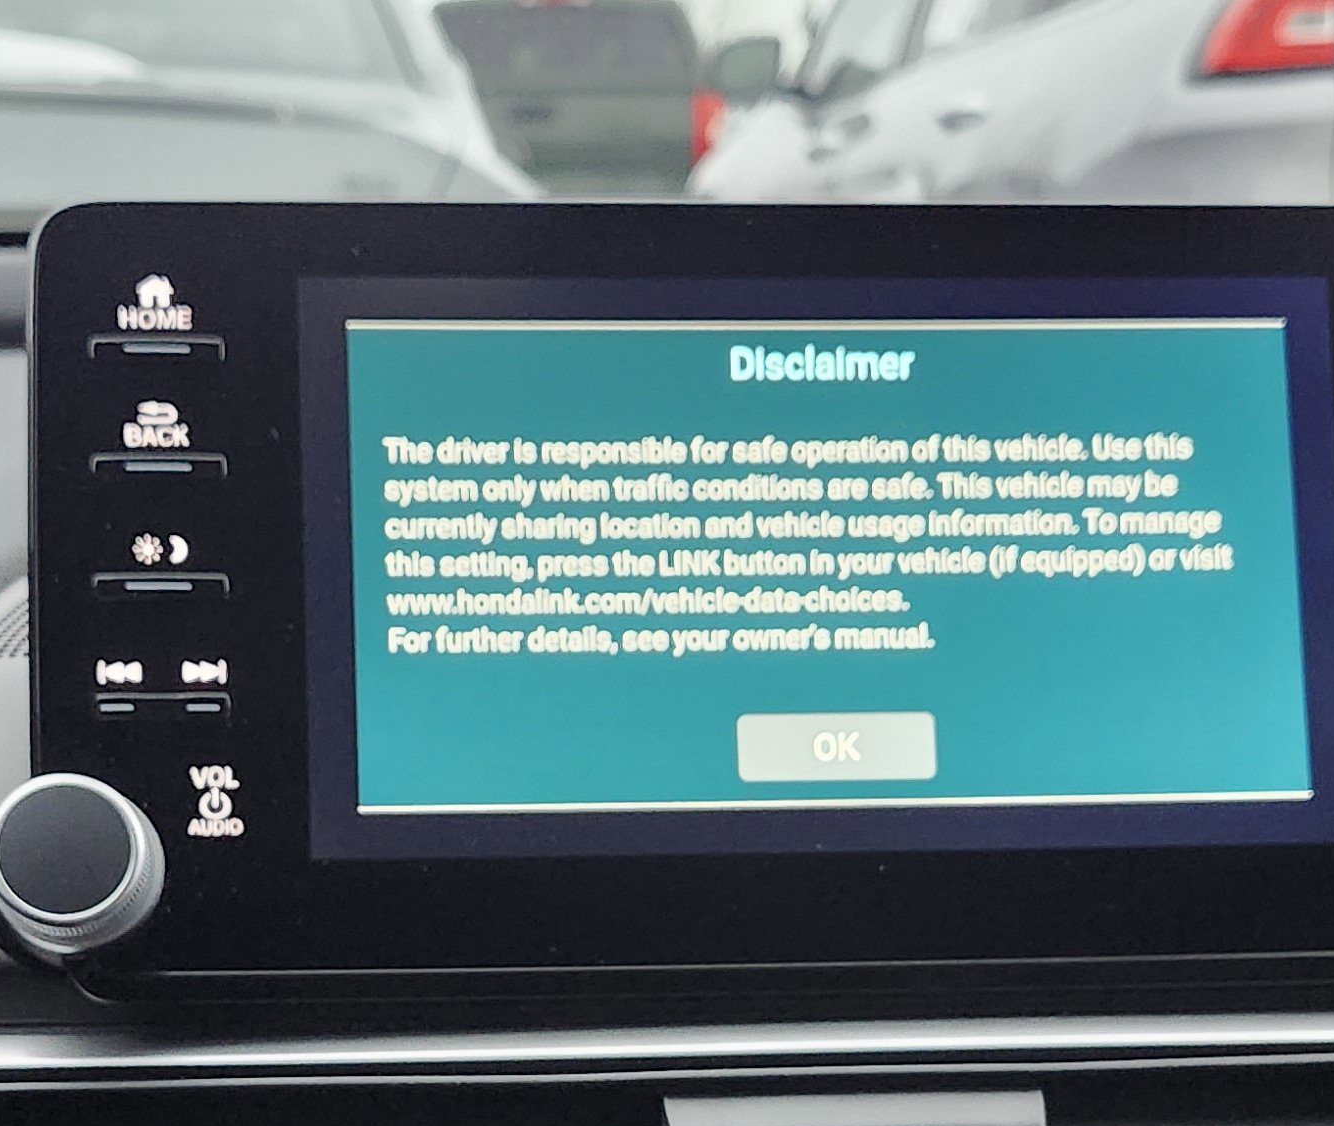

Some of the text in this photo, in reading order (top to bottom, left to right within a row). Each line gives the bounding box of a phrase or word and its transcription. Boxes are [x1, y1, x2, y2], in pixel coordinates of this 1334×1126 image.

[117, 305, 192, 330] HOME
[730, 344, 915, 381] Disclaimer
[123, 423, 190, 448] BACK
[383, 432, 1193, 469] The driver is responsible for safe operation of this vehicle. Use this
[385, 470, 1178, 507] system only when traffic conditions are safe. This vehicle may be
[385, 507, 1221, 545] currently sharing location and vehicle usage information. To manage
[385, 543, 1232, 582] this setting, press the LINK button in your vehicle (if equipped) or visit
[387, 586, 910, 615] www.hondalink.com/vehicle-data-choices.
[388, 622, 935, 656] For further details, see your owner's manual.
[813, 731, 860, 763] OK
[189, 765, 240, 789] VOL
[188, 817, 244, 837] AUDIO
